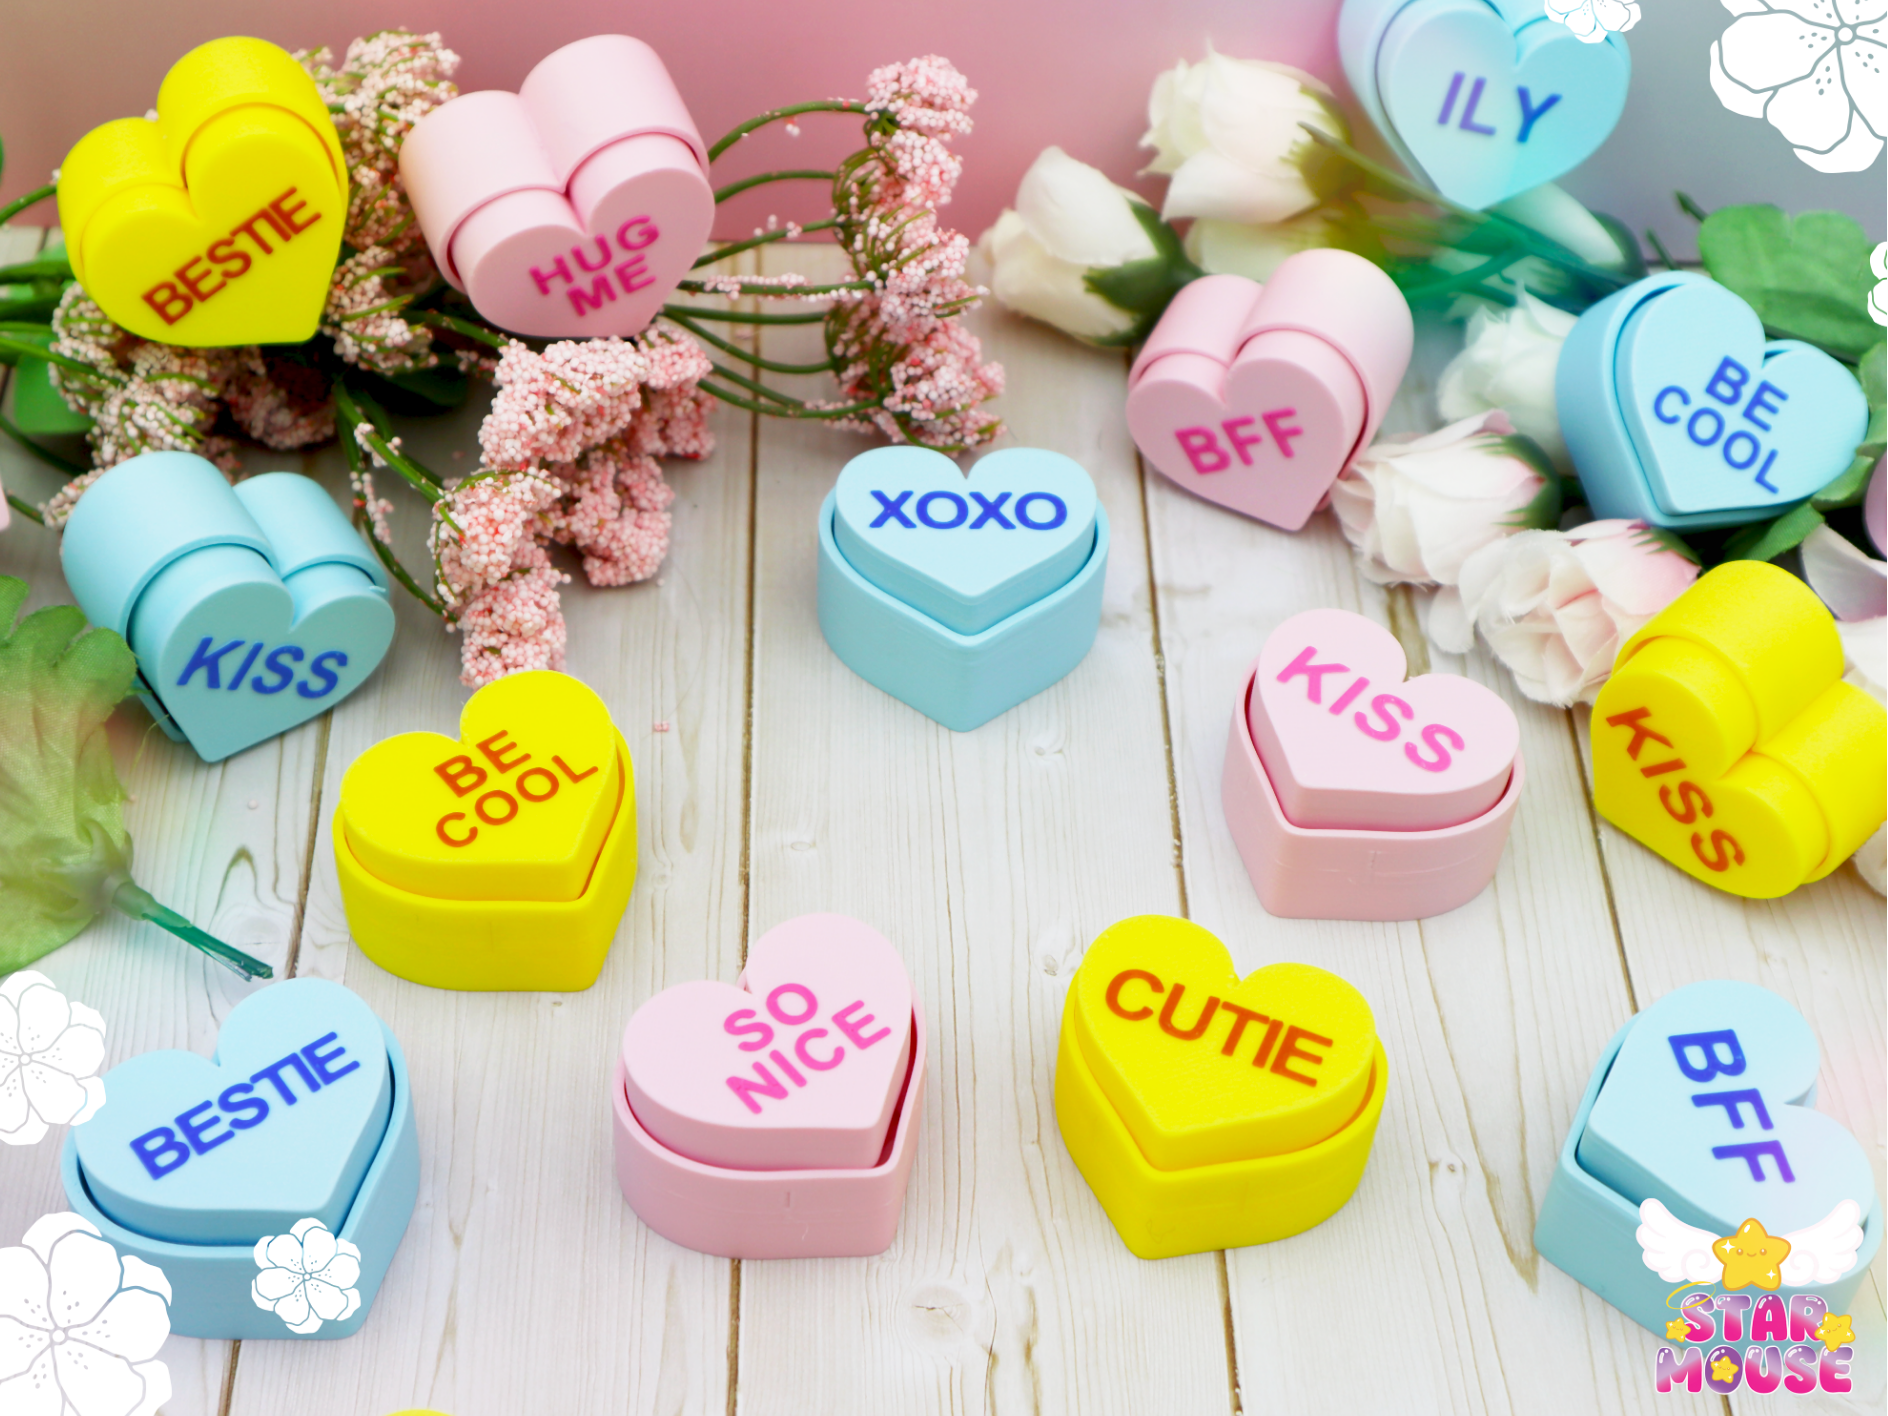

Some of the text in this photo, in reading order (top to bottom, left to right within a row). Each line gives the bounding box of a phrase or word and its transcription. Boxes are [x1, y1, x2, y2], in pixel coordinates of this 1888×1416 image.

[1437, 71, 1562, 143] ILY
[142, 186, 322, 326] BESTIE
[528, 214, 660, 296] HUG
[565, 254, 655, 317] ME
[1704, 355, 1788, 431] BE
[1175, 407, 1304, 475] BFF
[1653, 385, 1781, 494] COOL
[868, 490, 1069, 530] XOXO
[177, 636, 348, 700] KISS
[1276, 645, 1467, 774] KISS
[434, 730, 530, 797] BE
[436, 755, 598, 847] COOL
[1606, 706, 1746, 873] KISS
[723, 982, 818, 1053] SO
[726, 1000, 892, 1115] NICE
[1105, 969, 1334, 1088] CUTIE
[129, 1031, 360, 1181] BESTIE
[1667, 1028, 1796, 1184] BFF
